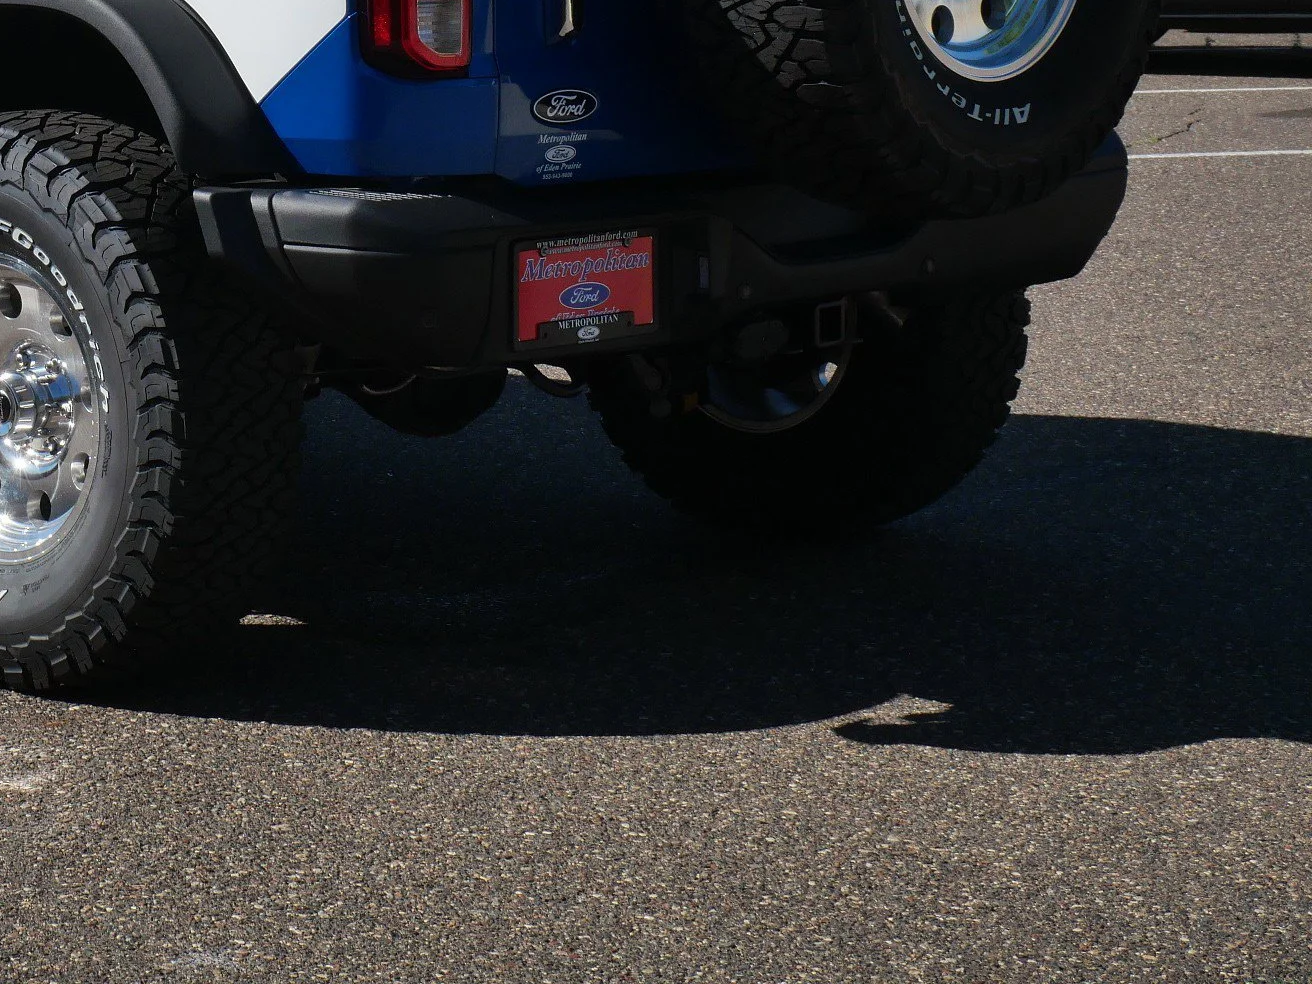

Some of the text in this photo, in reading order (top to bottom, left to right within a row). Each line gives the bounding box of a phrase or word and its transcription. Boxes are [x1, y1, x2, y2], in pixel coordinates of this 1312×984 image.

[895, 0, 1031, 126] All-Terrain
[547, 94, 587, 117] Ford
[538, 132, 588, 145] Metropolitan
[544, 164, 560, 172] Eden
[560, 162, 582, 171] Prairie
[536, 230, 638, 249] www.metropolitanford.com
[521, 248, 650, 283] Metropolitan
[570, 287, 600, 304] Ford
[558, 314, 620, 330] METROPOLITAN
